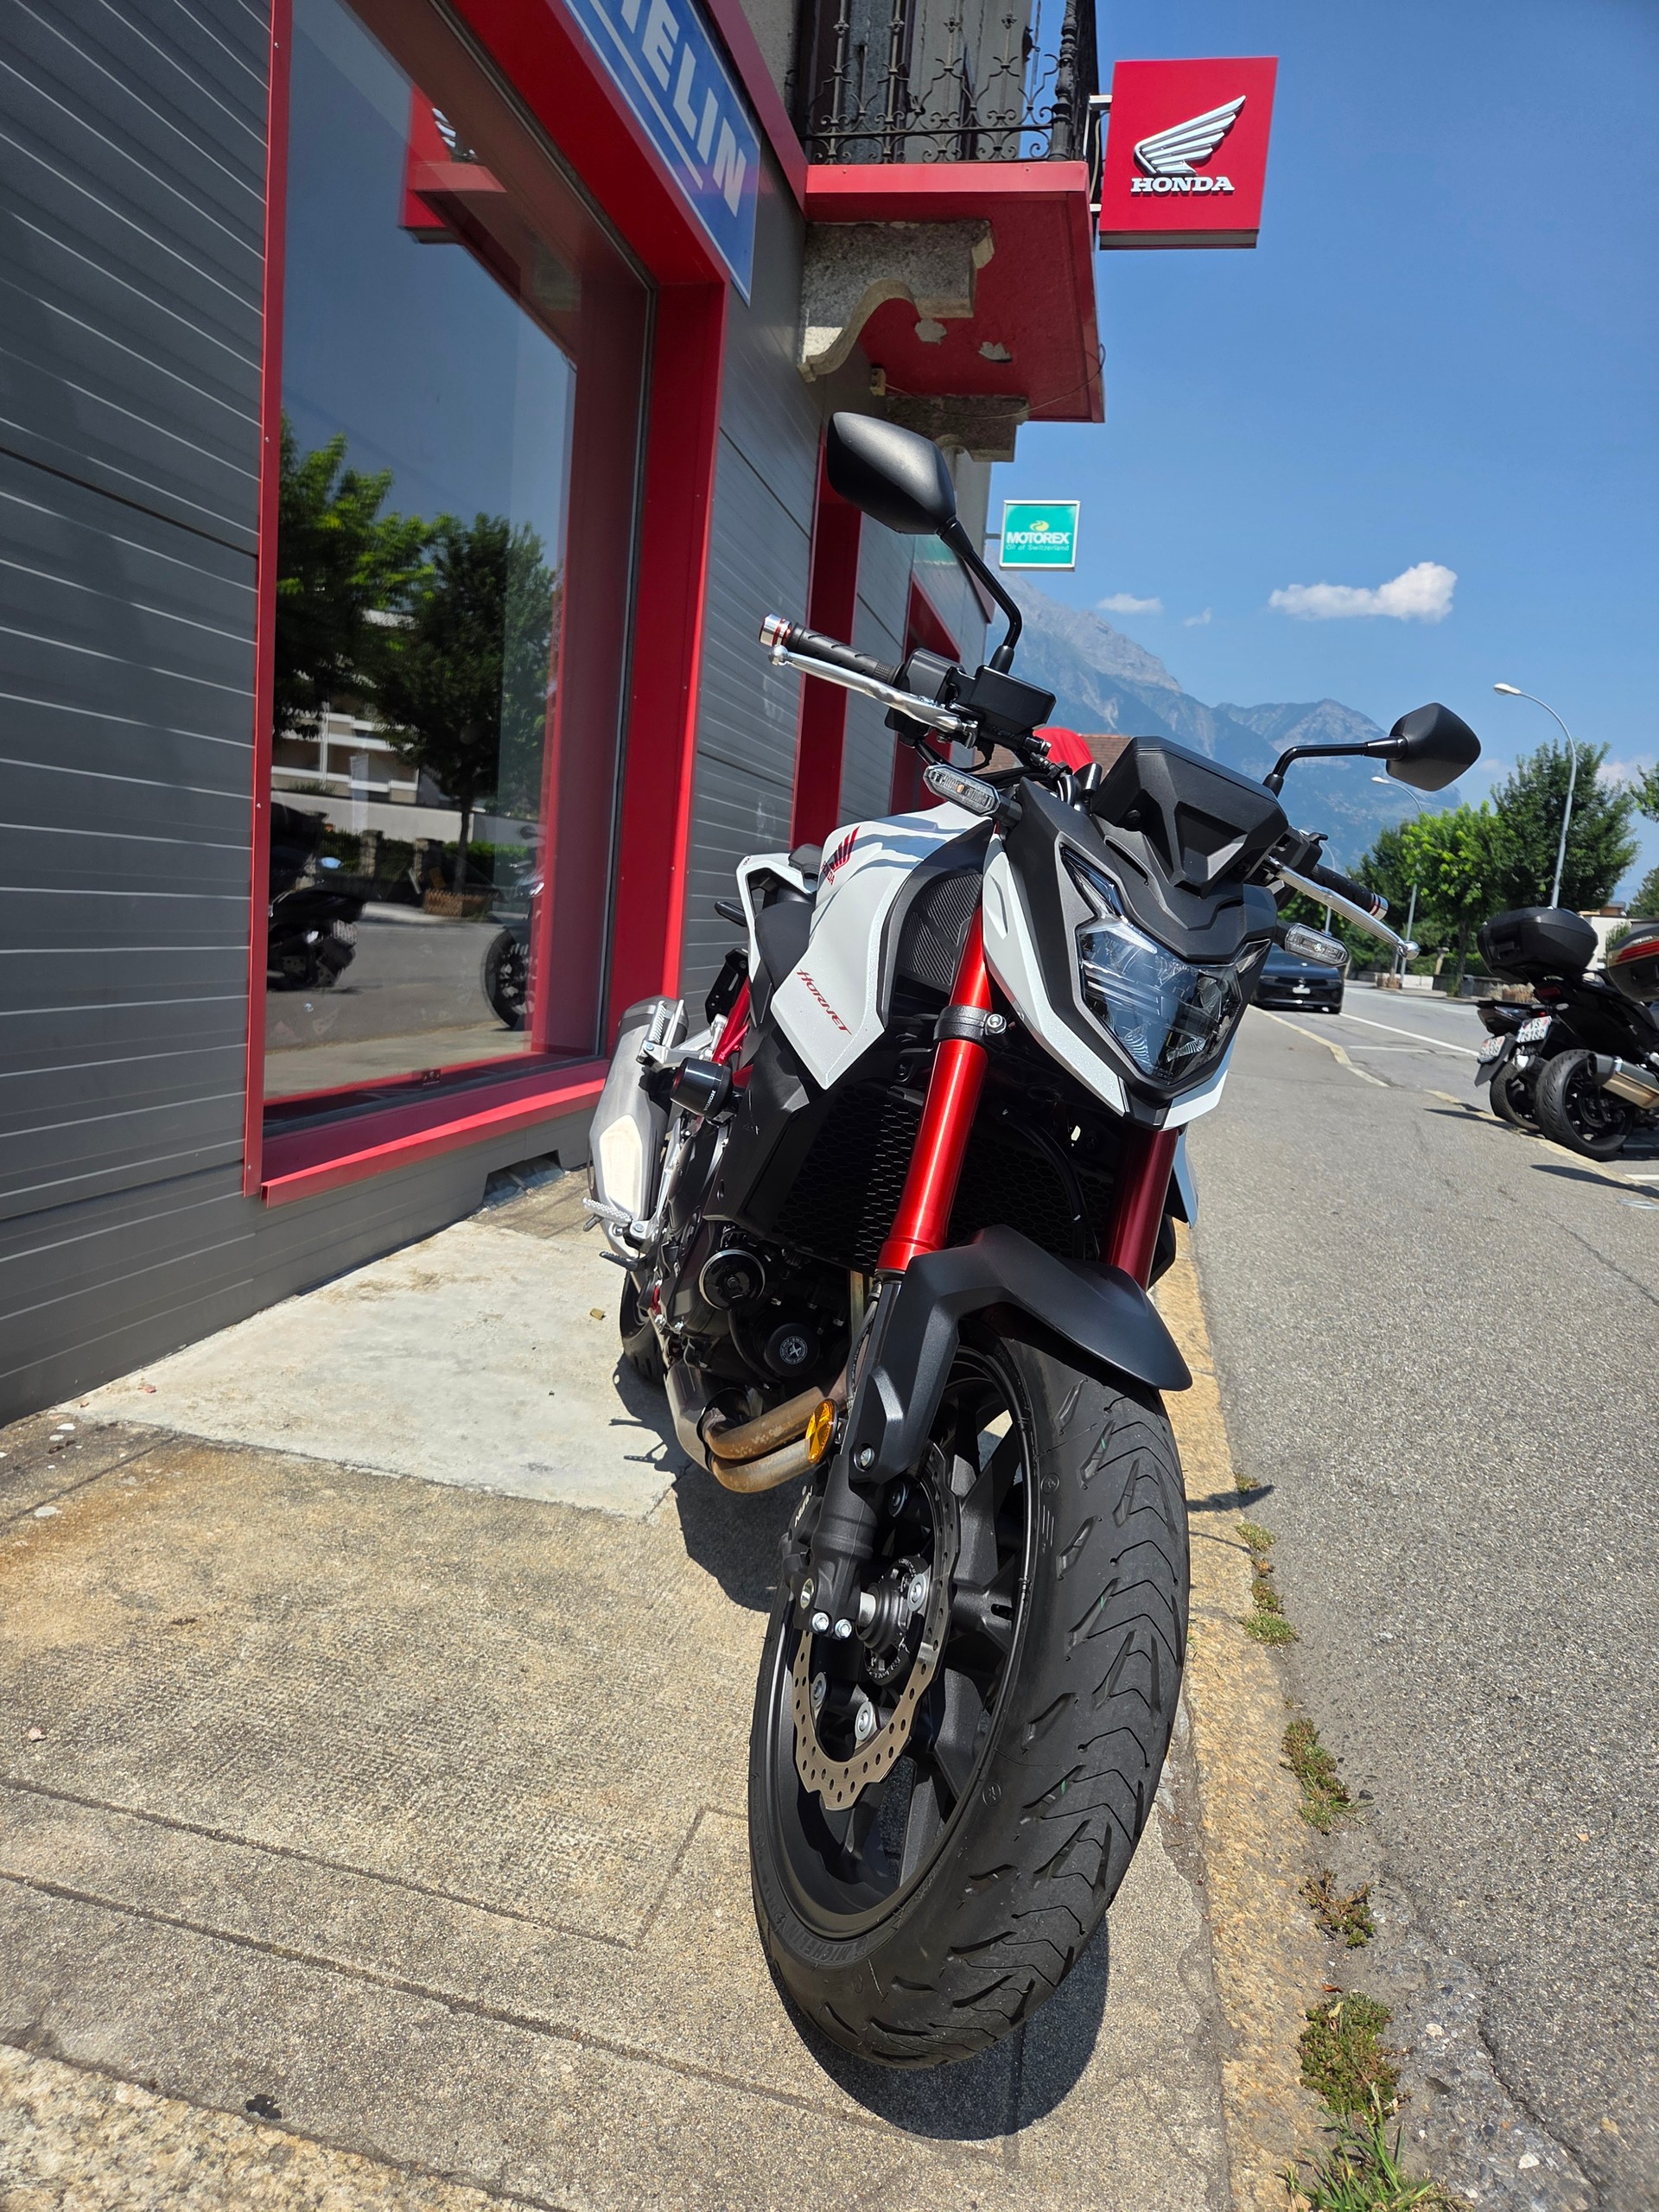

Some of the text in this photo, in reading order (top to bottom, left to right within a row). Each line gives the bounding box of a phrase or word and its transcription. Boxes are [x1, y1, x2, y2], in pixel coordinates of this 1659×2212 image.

[620, 0, 747, 218] ELIN
[1130, 176, 1235, 193] HONDA
[1006, 531, 1072, 544] MOTOREX
[703, 1090, 716, 1111] HONDA
